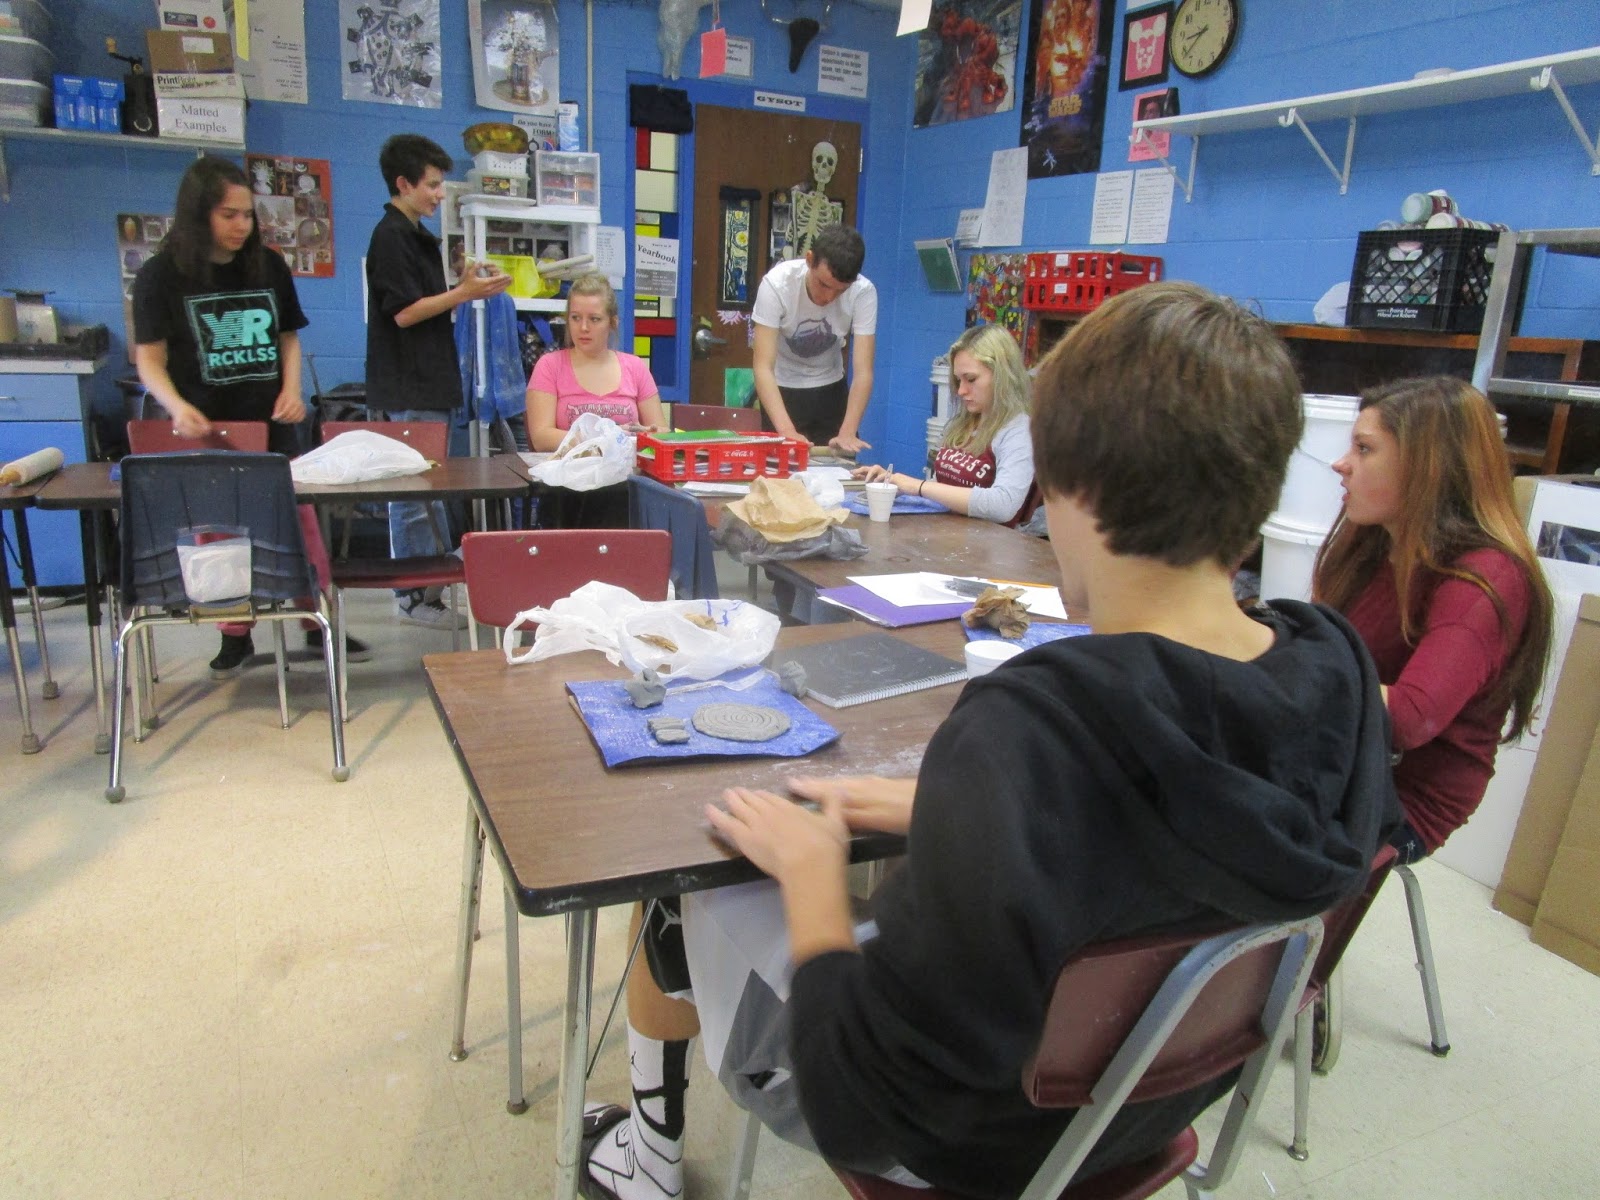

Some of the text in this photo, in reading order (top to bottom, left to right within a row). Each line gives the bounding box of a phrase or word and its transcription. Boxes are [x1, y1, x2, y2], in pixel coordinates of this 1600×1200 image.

[756, 95, 803, 107] GYSOT
[181, 104, 219, 118] Matted
[175, 118, 228, 133] Examples
[638, 244, 677, 265] Yearbook
[208, 346, 277, 367] RCKLSS
